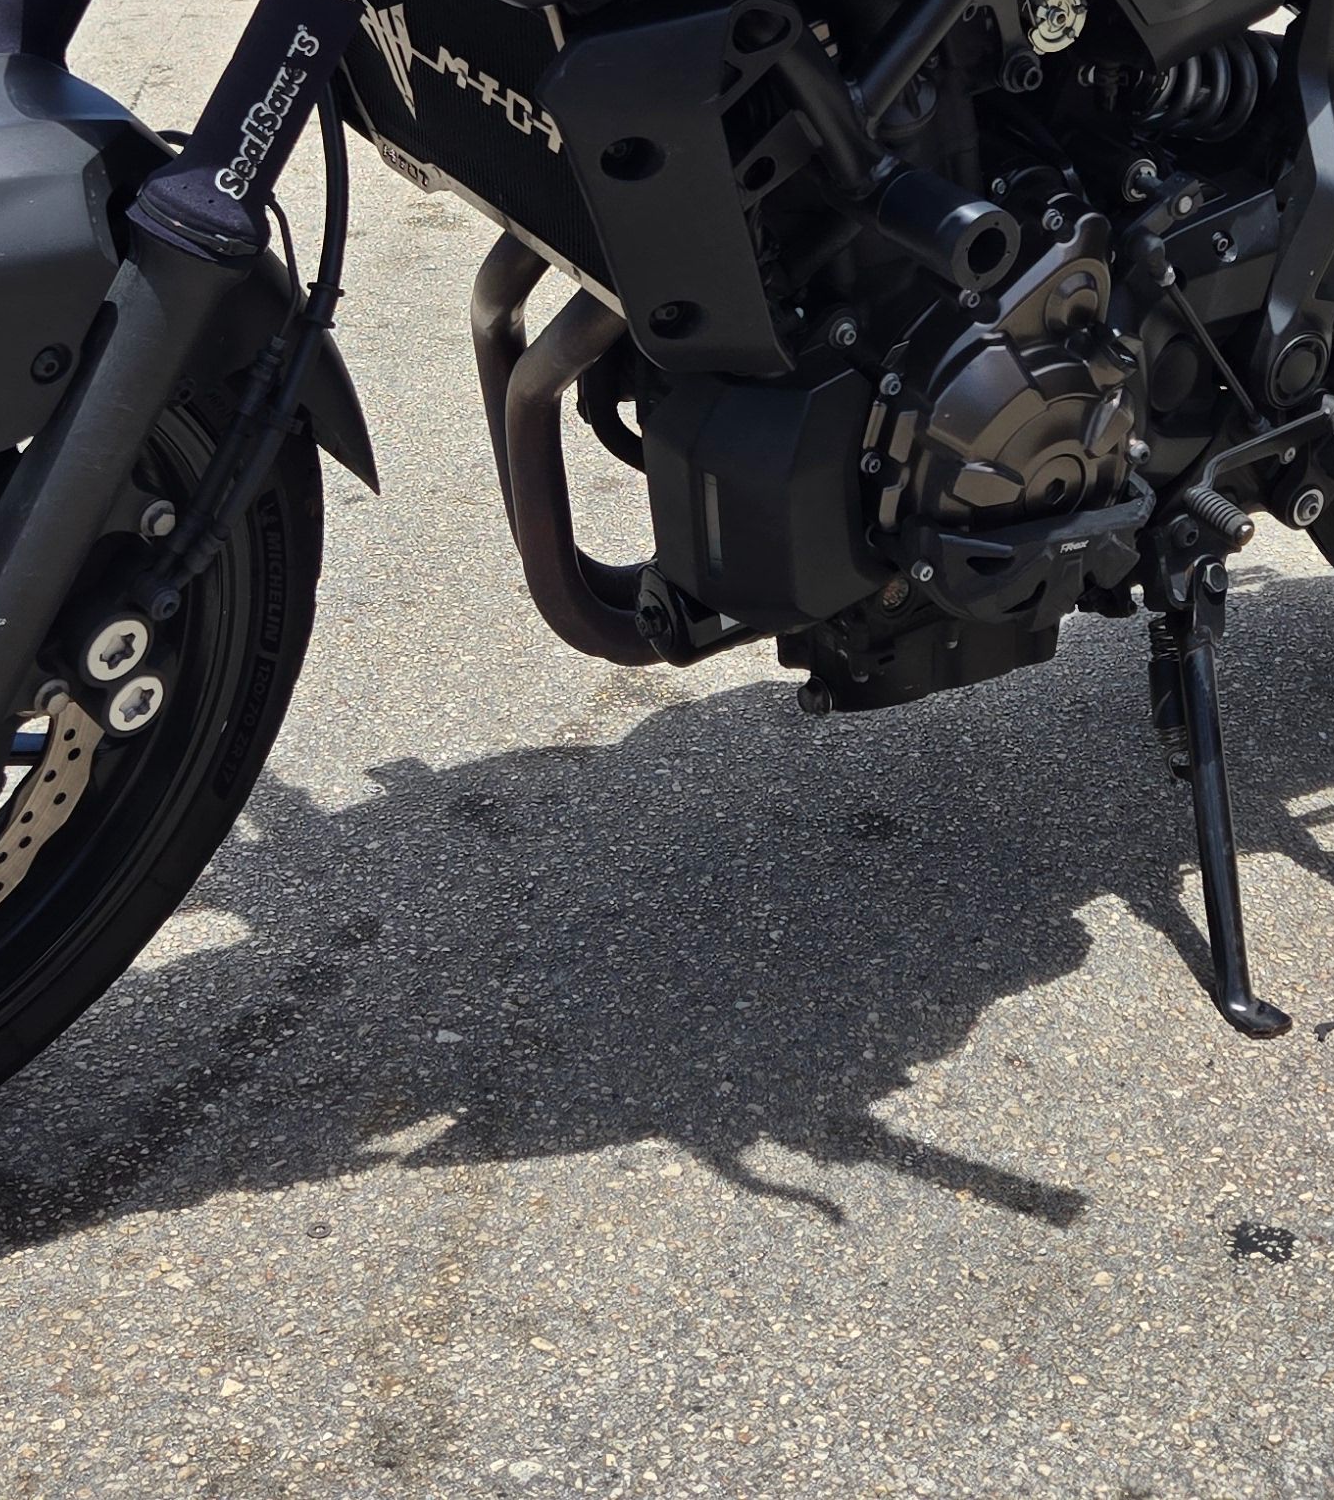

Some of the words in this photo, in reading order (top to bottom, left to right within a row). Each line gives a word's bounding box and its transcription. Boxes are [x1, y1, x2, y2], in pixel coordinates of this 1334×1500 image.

[265, 531, 282, 642] MICHELIN
[243, 663, 270, 727] 120/70
[230, 731, 250, 758] ZR
[221, 761, 238, 784] 17
